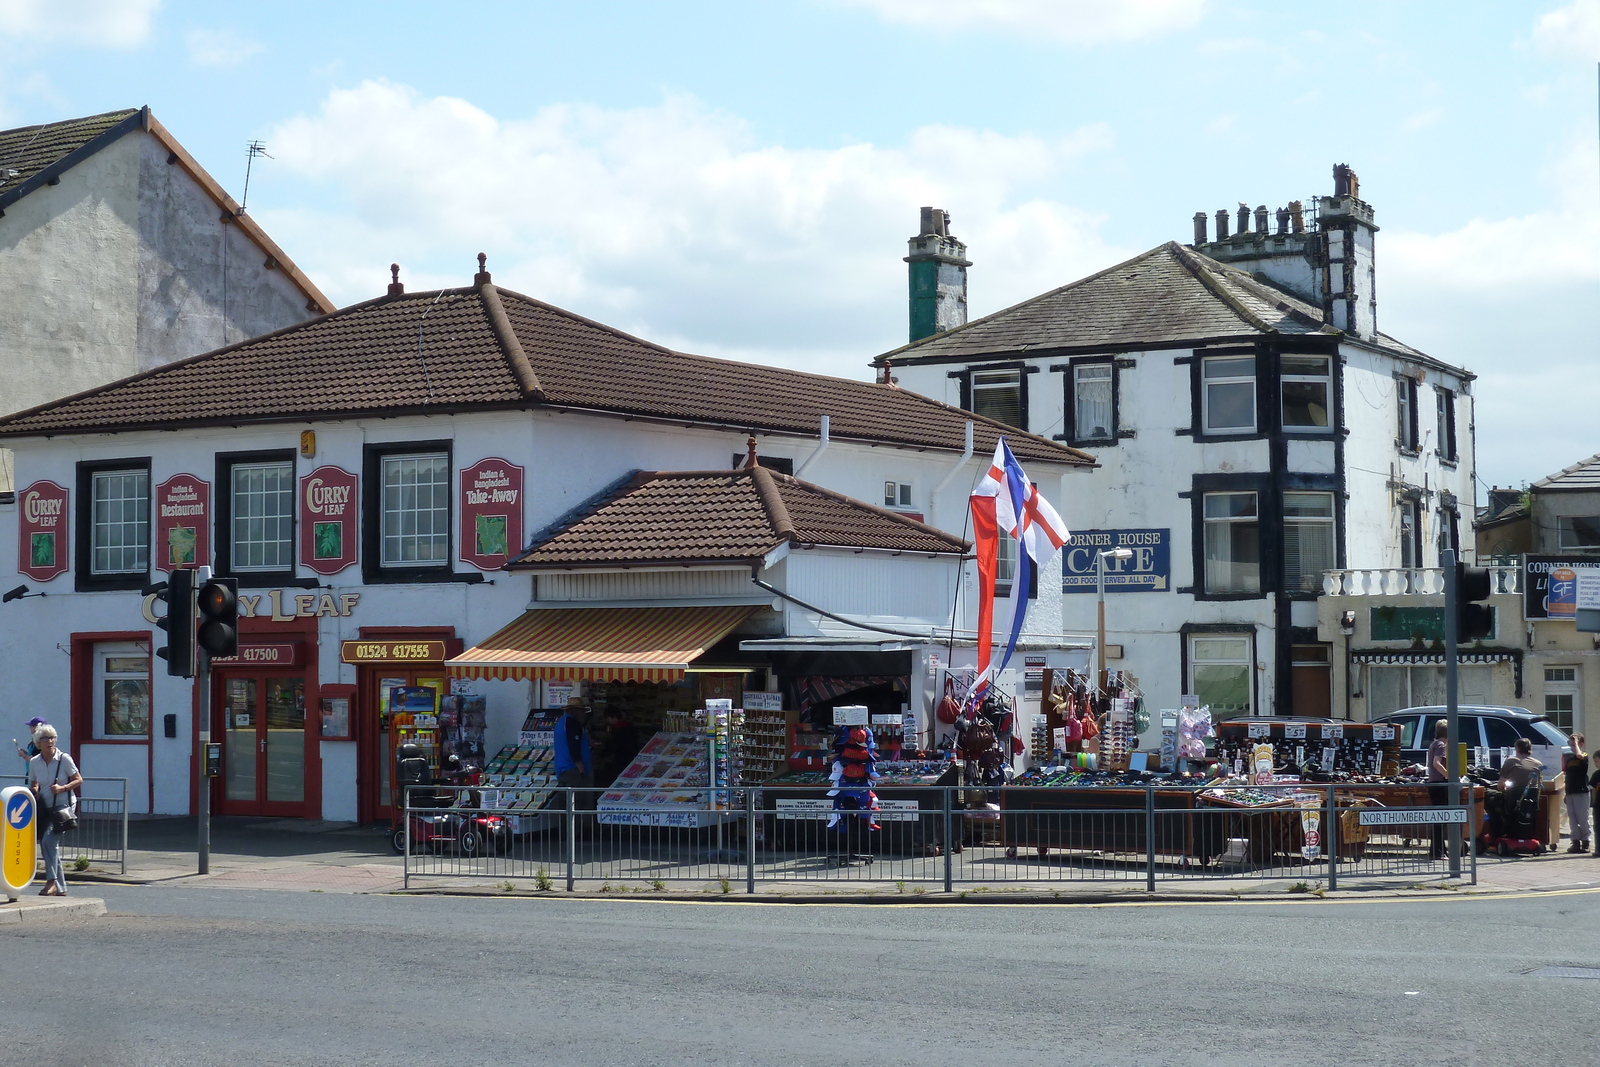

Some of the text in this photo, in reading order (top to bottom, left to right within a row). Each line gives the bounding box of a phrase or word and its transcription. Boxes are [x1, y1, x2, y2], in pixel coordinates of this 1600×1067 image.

[479, 469, 505, 479] Indian &
[474, 477, 510, 489] Bangladeshi
[306, 478, 350, 513] CURRY
[466, 489, 518, 505] Take-Away
[24, 491, 63, 524] CURRY
[161, 502, 204, 517] Restaurant
[324, 504, 345, 516] LEAF
[40, 516, 58, 527] LEAF
[1117, 532, 1161, 545] HOUSE
[1104, 576, 1126, 584] ERVED
[1143, 575, 1156, 583] DAY
[268, 590, 360, 622] LEAF
[243, 647, 278, 661] 417500
[356, 644, 430, 658] 01524 417555
[520, 731, 536, 740] Fudge
[1362, 811, 1464, 823] NORTHUMBERLAND ST
